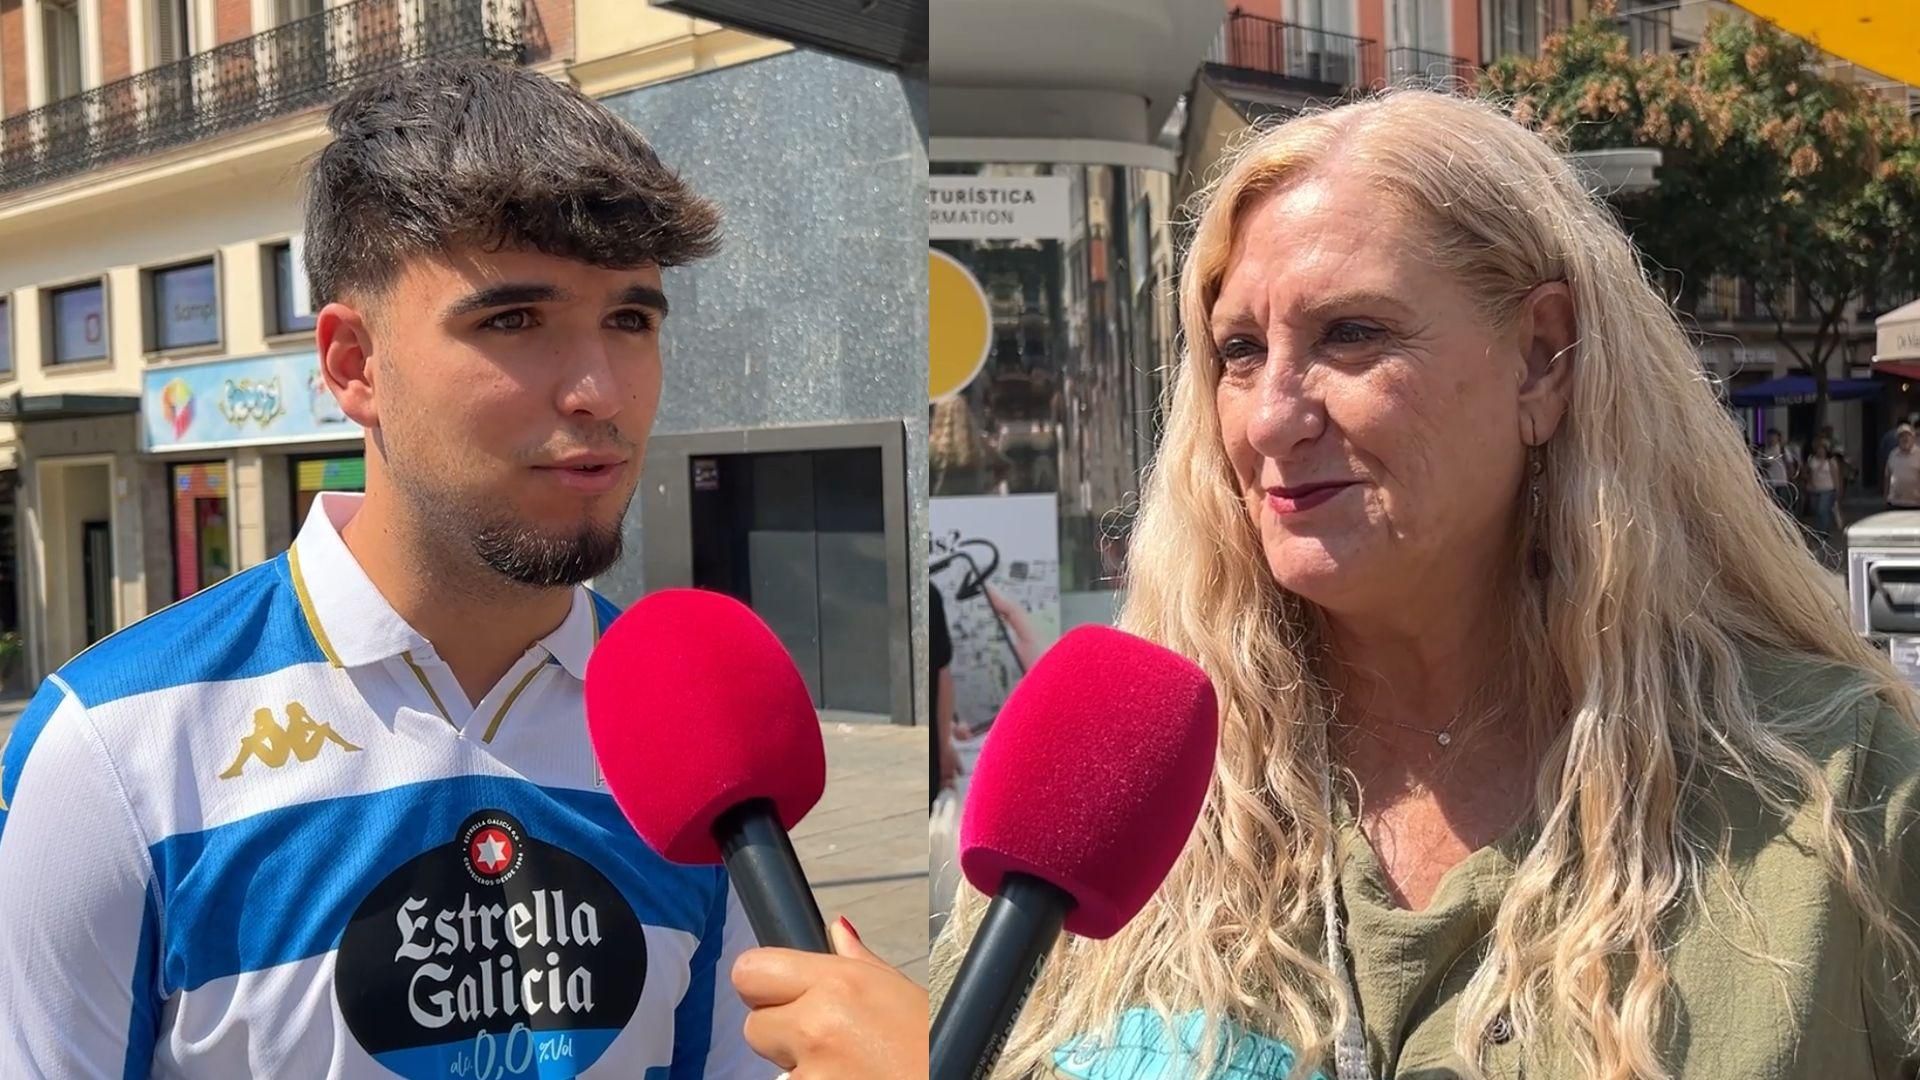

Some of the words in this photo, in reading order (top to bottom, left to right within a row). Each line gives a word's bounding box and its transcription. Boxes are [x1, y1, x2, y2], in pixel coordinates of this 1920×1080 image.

[929, 187, 1036, 205] TURÍSTICA
[929, 209, 1015, 225] RMATION
[394, 889, 602, 963] Estrella
[408, 951, 595, 1029] Galicia
